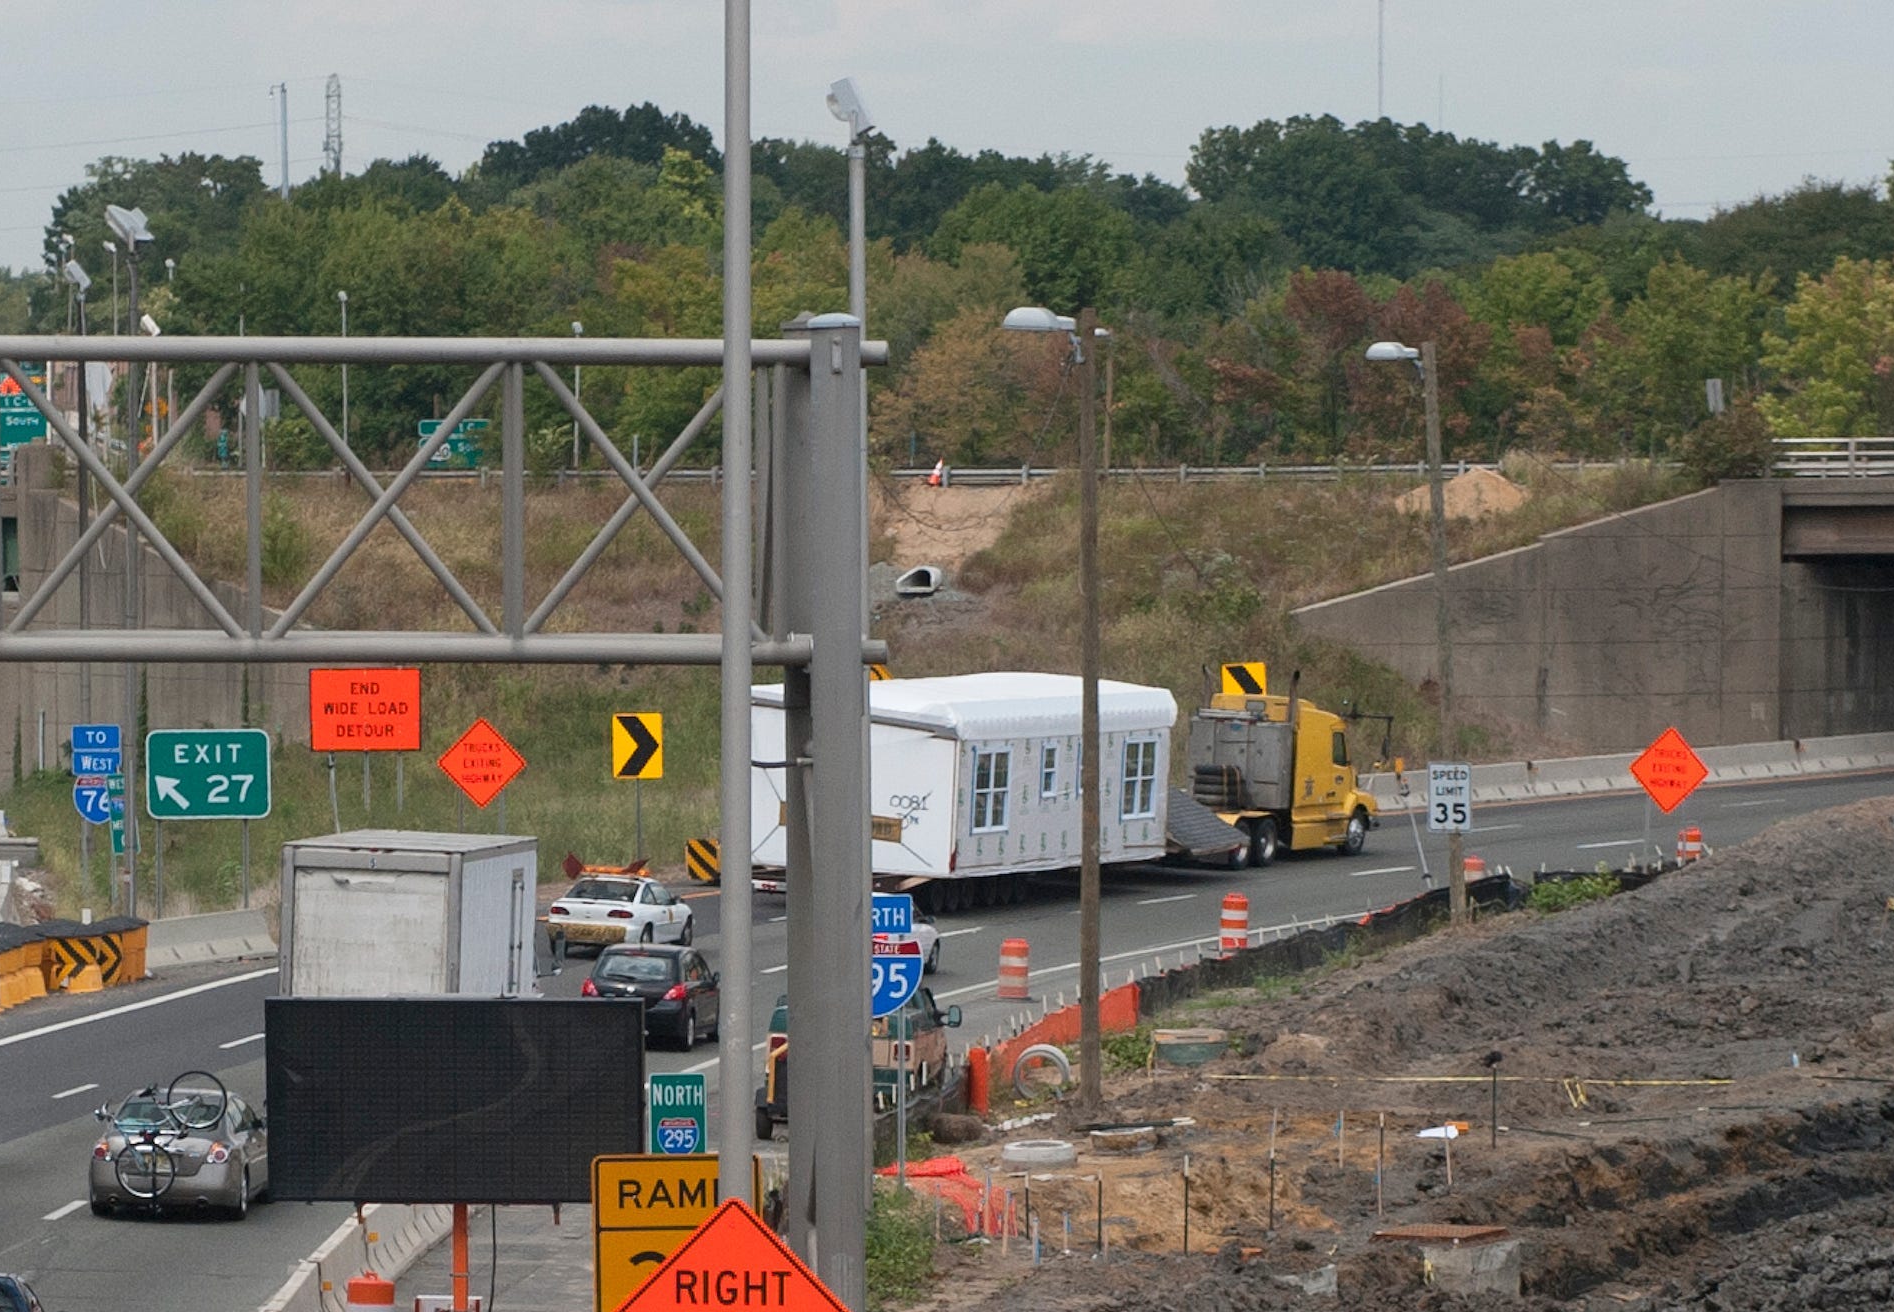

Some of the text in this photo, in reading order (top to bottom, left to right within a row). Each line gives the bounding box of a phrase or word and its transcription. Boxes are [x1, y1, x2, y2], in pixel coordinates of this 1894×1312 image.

[350, 682, 380, 696] END
[323, 702, 409, 715] WIDE LOAD
[85, 731, 108, 745] TO
[336, 723, 395, 738] DETOUR
[174, 743, 242, 764] EXIT
[463, 743, 502, 753] TRUCKS
[80, 755, 114, 771] WEST
[1432, 769, 1468, 781] SPEED
[206, 774, 255, 804] 27
[1435, 786, 1466, 797] LIMIT
[1435, 802, 1467, 825] 35
[872, 907, 906, 927] RTH
[872, 963, 909, 999] 95
[652, 1083, 703, 1107] NORTH
[664, 1129, 695, 1149] 295
[618, 1178, 719, 1210] RAM
[676, 1270, 792, 1306] RIGHT
